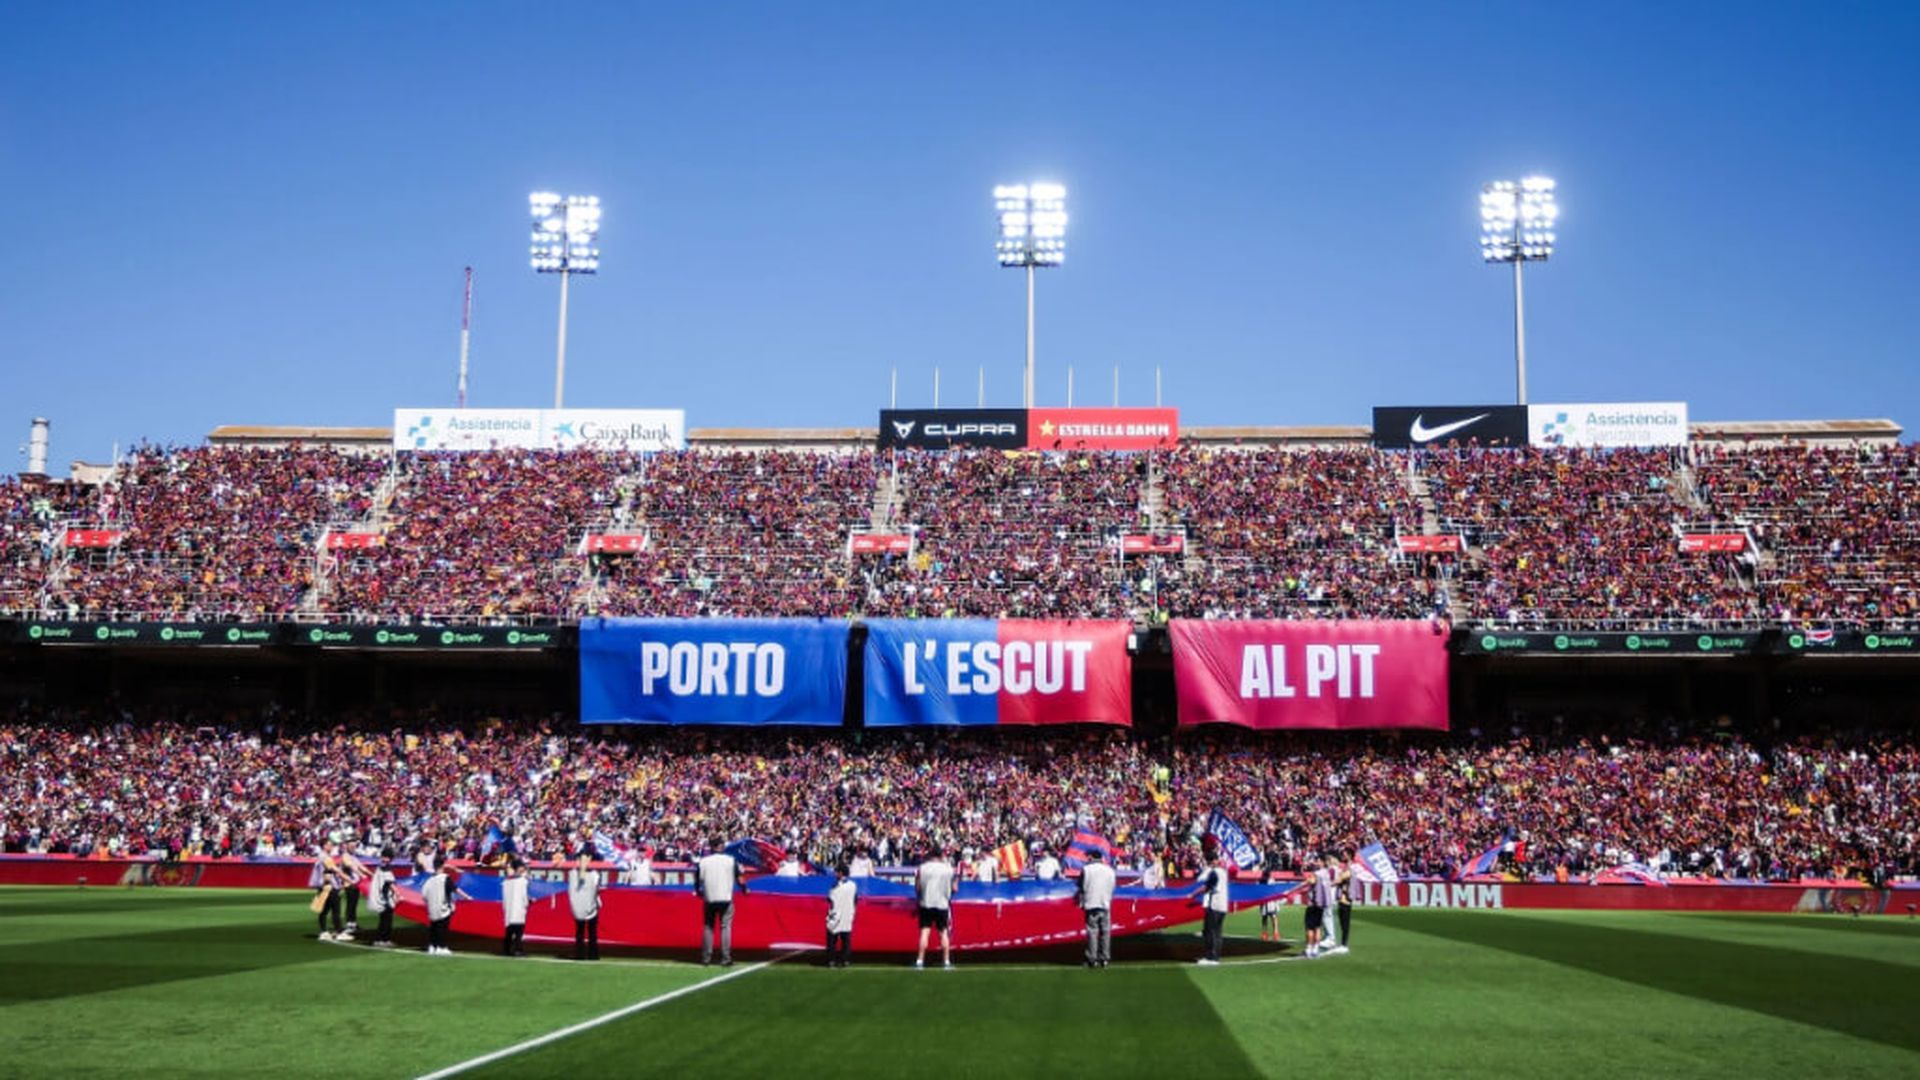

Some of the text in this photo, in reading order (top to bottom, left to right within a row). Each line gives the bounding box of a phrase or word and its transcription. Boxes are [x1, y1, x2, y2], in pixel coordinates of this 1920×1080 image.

[579, 421, 672, 443] CaixaBank
[923, 423, 1017, 436] CUPRA
[1058, 423, 1169, 437] ESTRELLA DAMM
[641, 641, 786, 697] PORTO
[1240, 644, 1381, 698] AL PIT
[1408, 882, 1503, 907] DAMM
